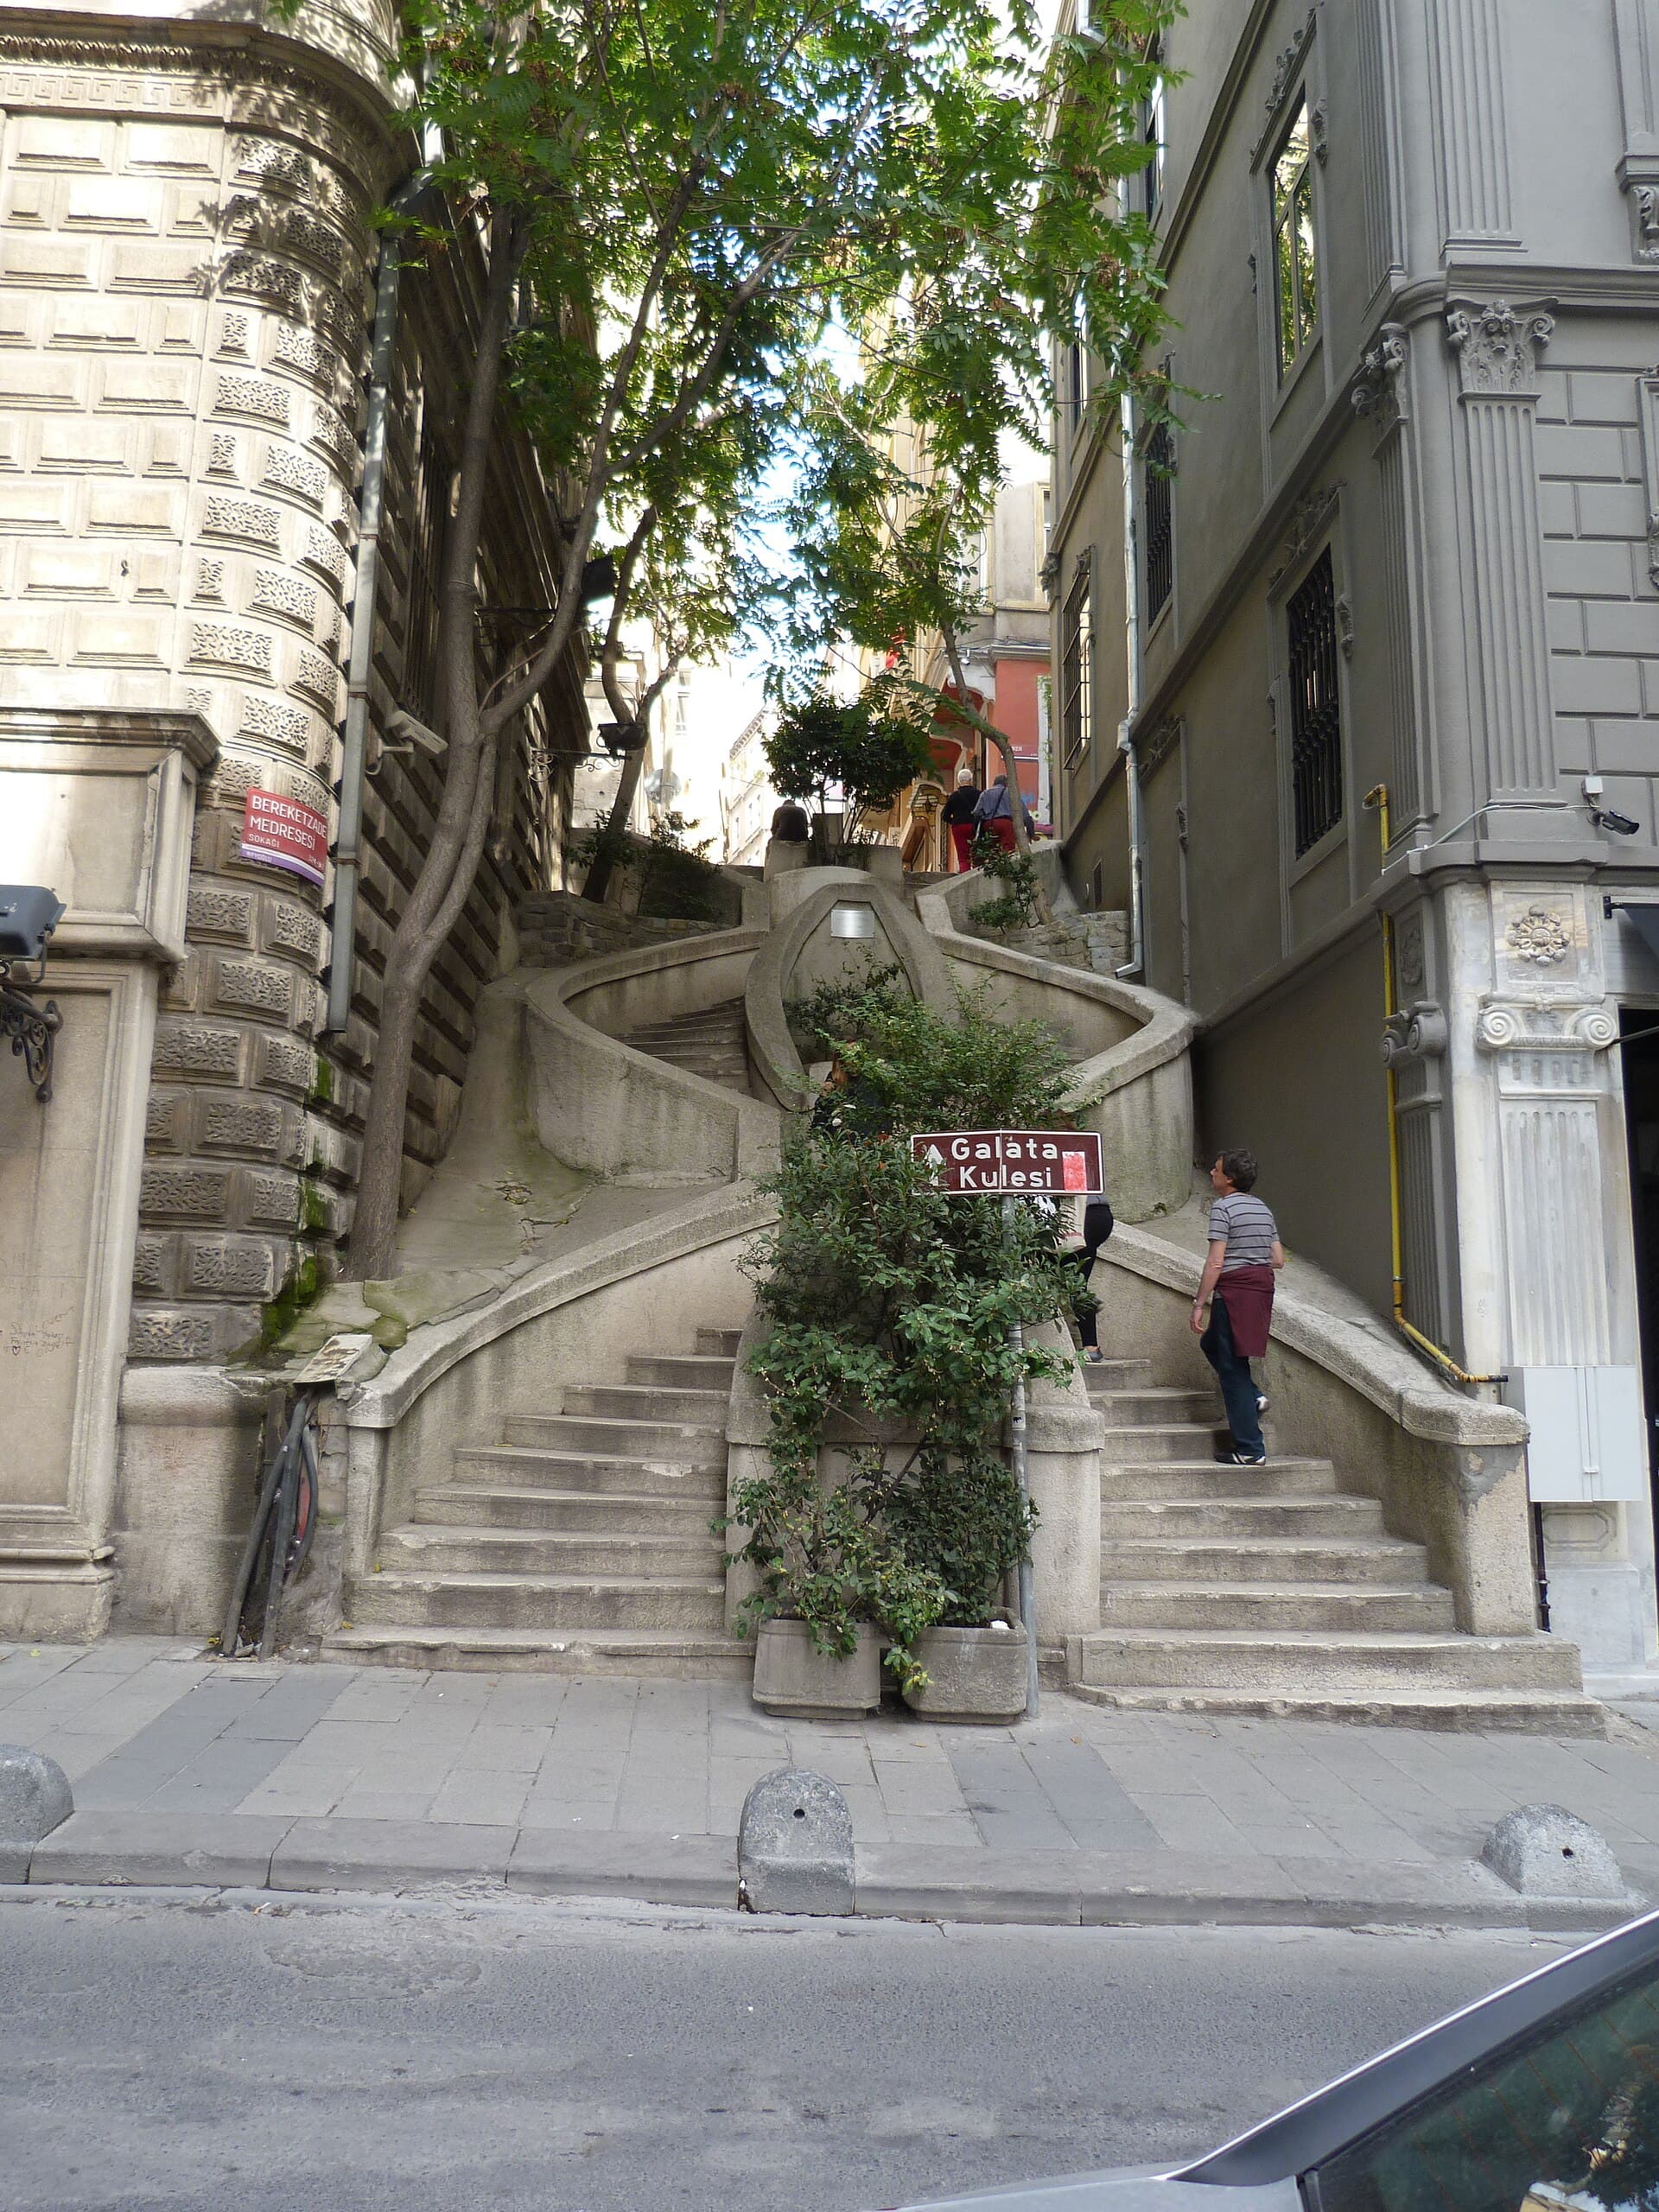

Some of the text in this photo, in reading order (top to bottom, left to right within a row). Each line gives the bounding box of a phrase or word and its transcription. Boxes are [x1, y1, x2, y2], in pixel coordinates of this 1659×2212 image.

[251, 795, 327, 839] BEREKETZADE
[951, 1136, 1058, 1160] Galata
[959, 1165, 1052, 1189] Kulesi
